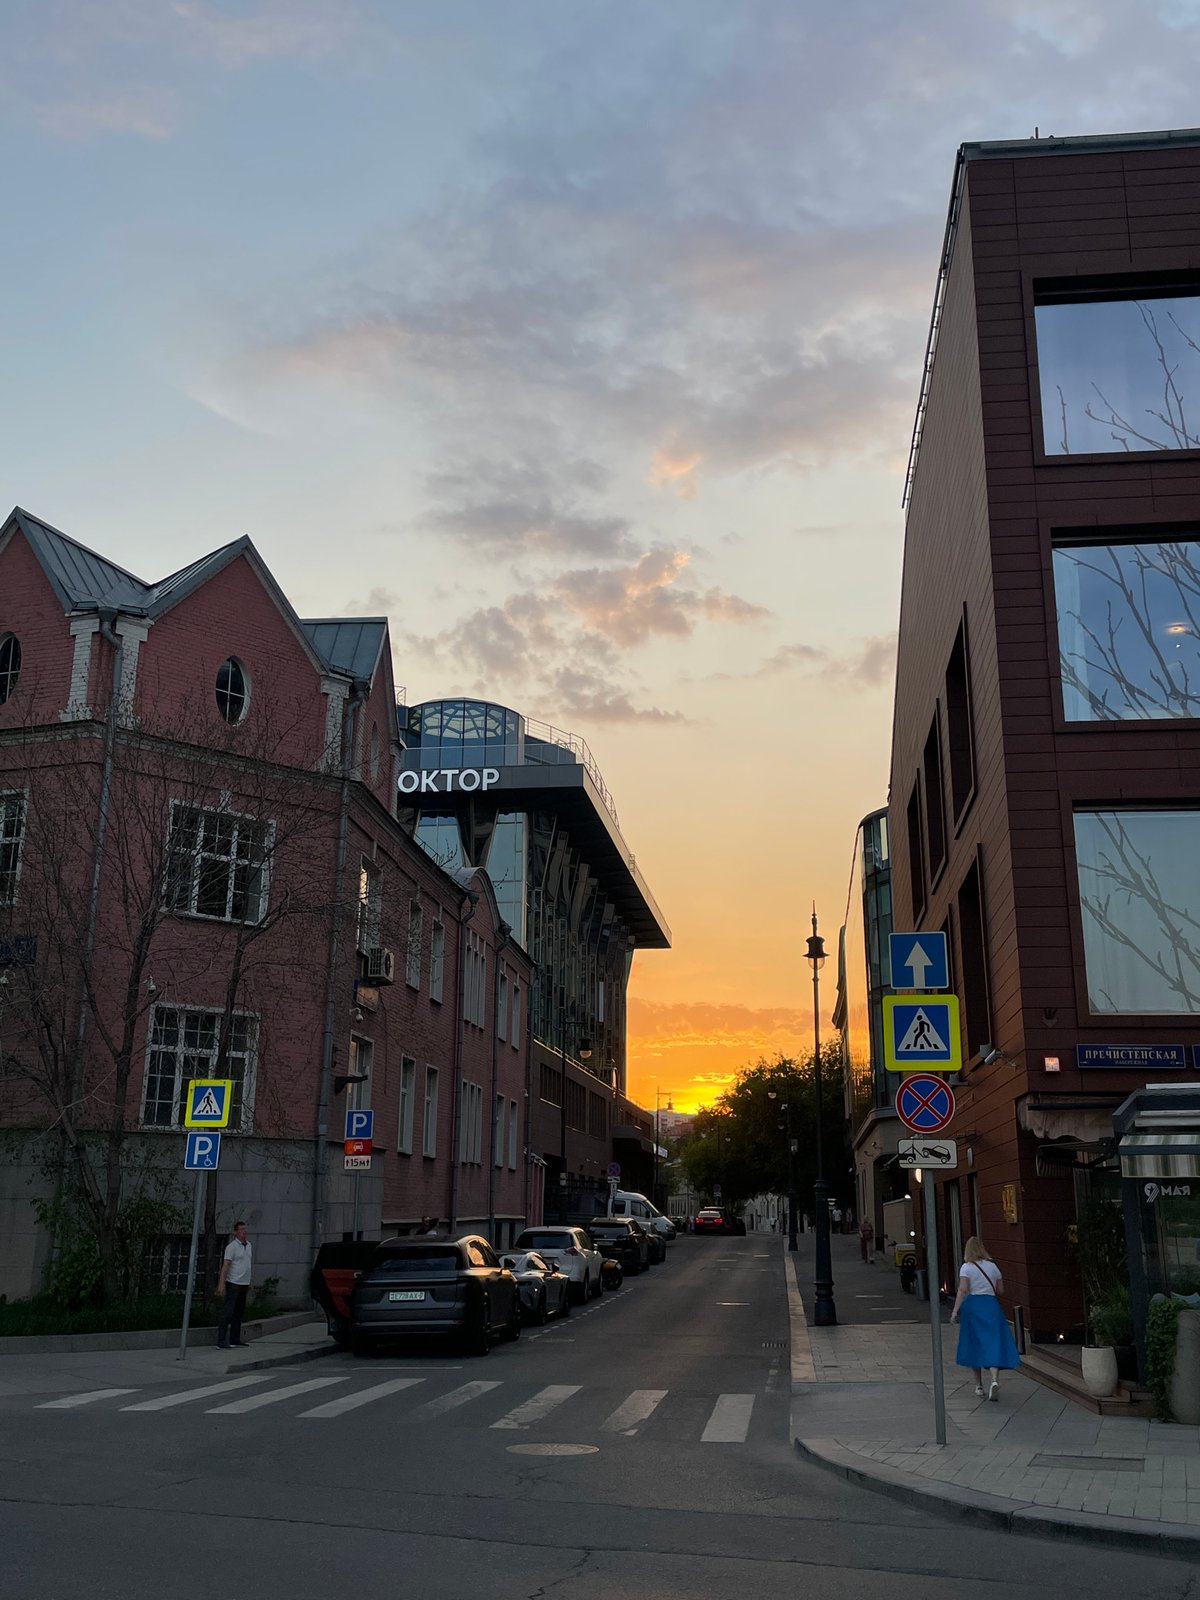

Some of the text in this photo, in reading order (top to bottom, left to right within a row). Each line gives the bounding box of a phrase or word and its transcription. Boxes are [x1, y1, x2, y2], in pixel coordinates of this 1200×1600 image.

[1085, 1050, 1177, 1060] ПРЕЧИСТЕНСКАЯ
[352, 1113, 367, 1136] P
[193, 1136, 213, 1165] P
[1144, 1182, 1191, 1202] 9 МАЯ
